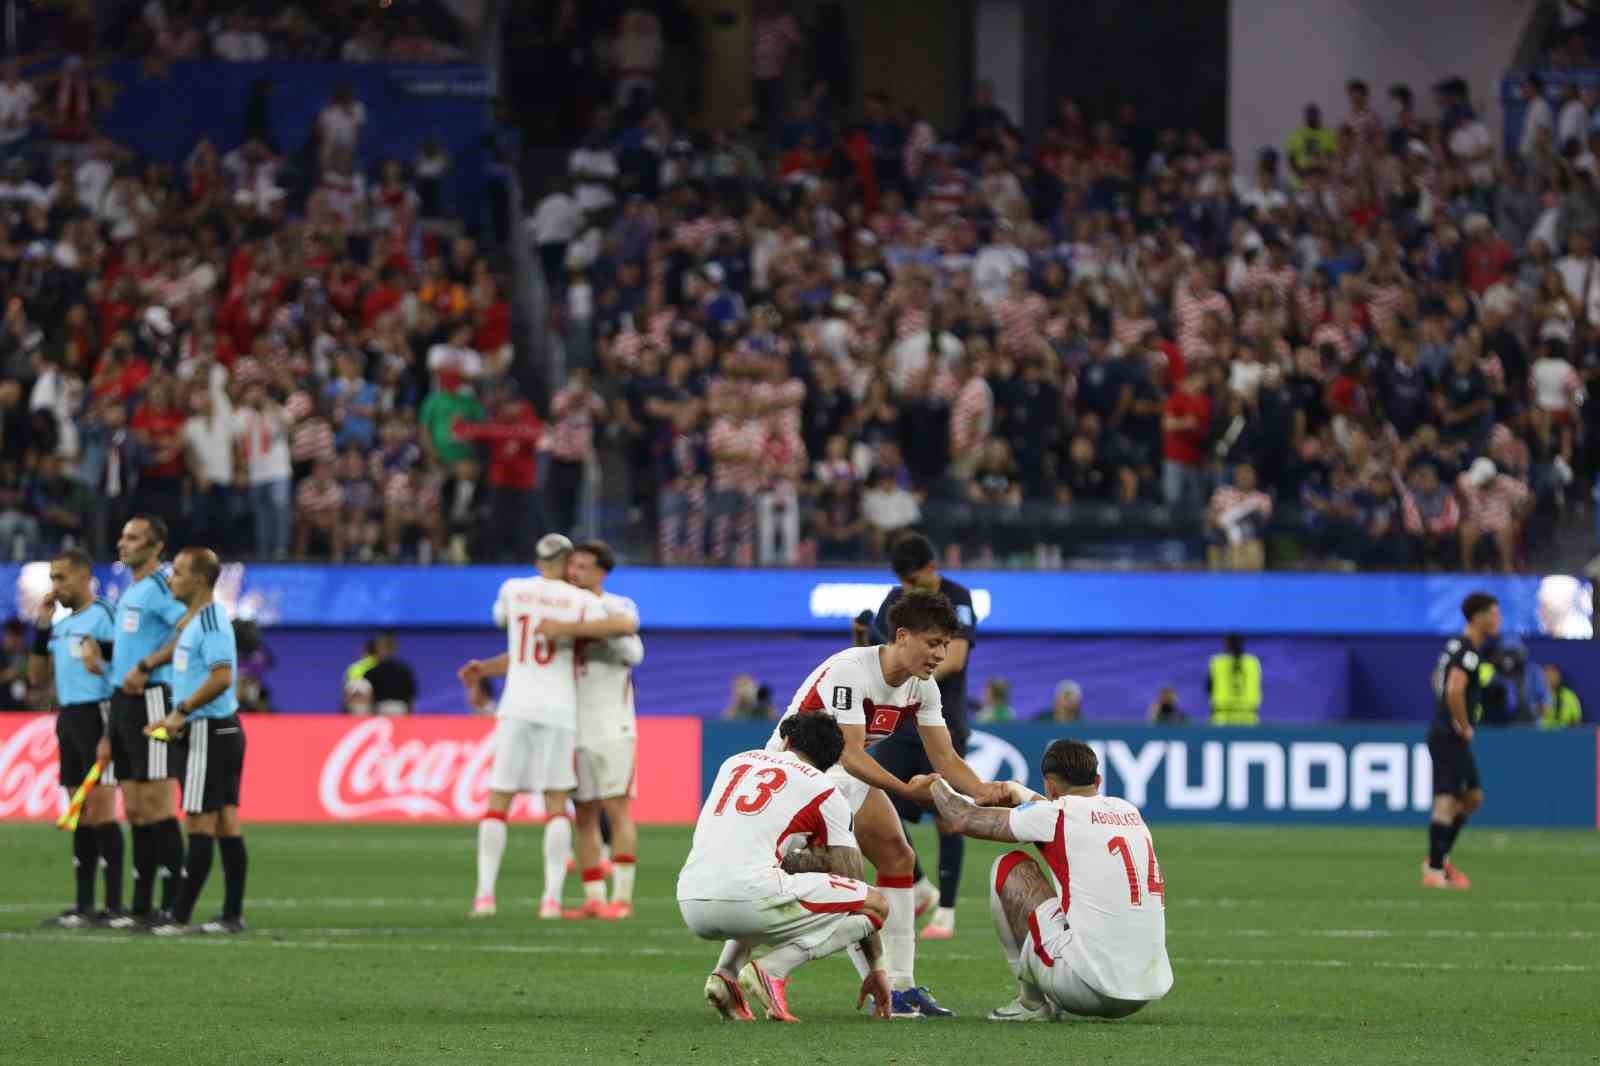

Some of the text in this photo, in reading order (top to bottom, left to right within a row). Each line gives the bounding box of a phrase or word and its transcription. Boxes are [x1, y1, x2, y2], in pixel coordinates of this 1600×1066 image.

[714, 763, 788, 816] 13
[1089, 739, 1434, 811] YUNDAI
[1107, 835, 1165, 907] 14
